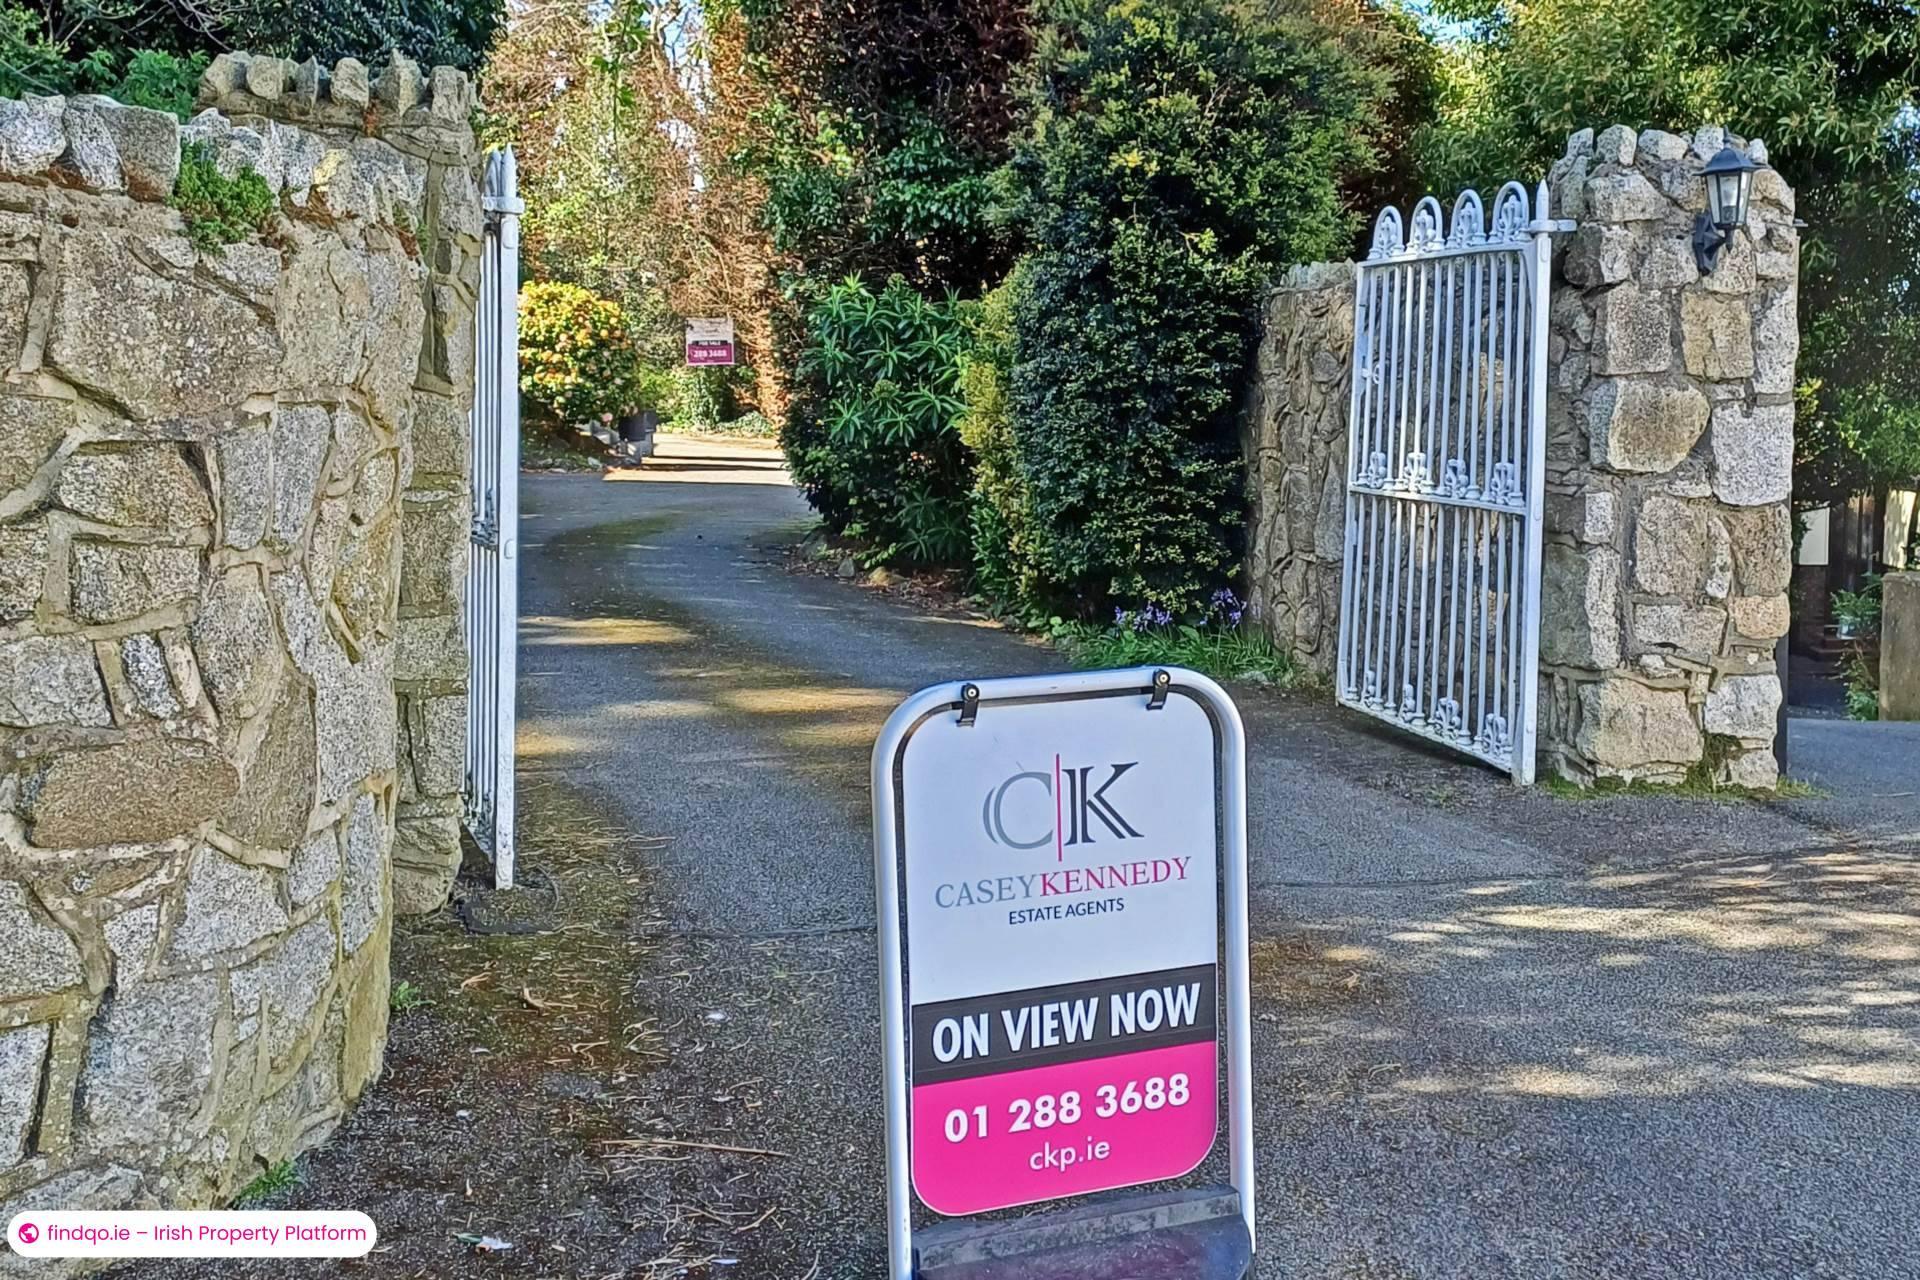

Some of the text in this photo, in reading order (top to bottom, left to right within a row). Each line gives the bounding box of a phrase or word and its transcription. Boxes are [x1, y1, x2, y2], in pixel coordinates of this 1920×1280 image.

[1009, 897, 1125, 925] ESTATE AGENTS
[932, 982, 1201, 1063] ON VIEW NOW
[944, 1073, 1190, 1143] 01 288 3688
[1029, 1136, 1111, 1172] ckp.ie
